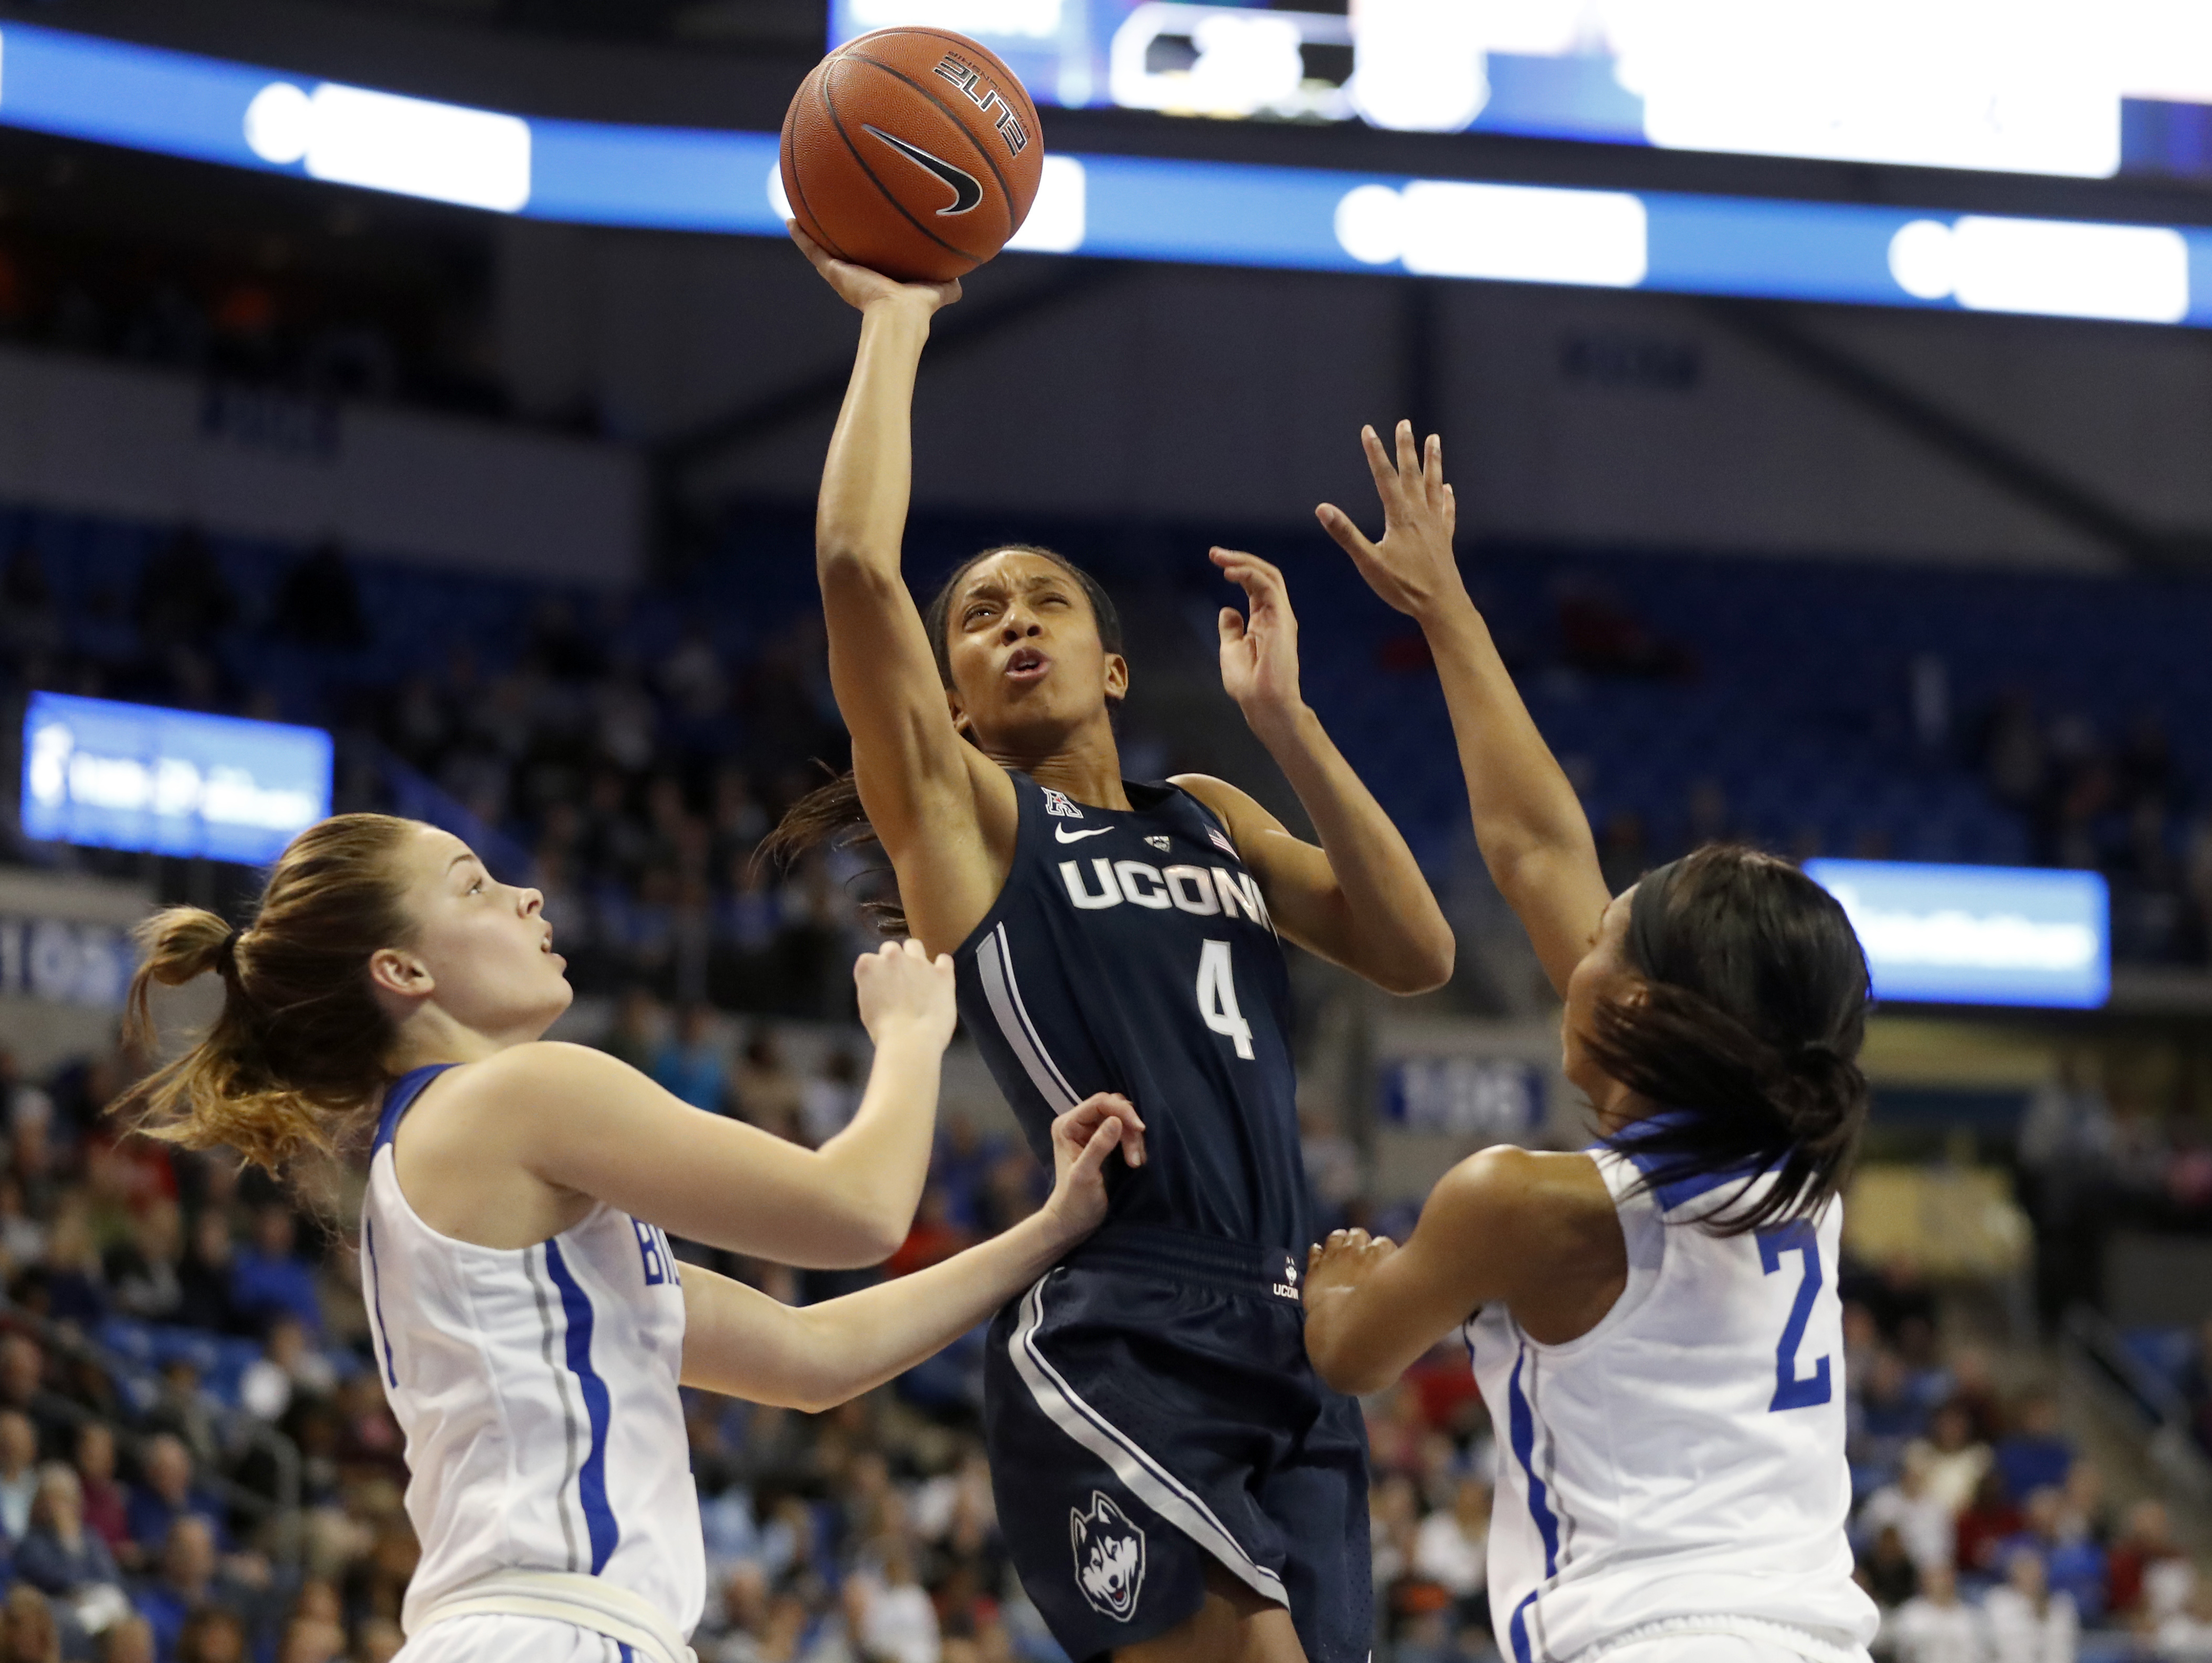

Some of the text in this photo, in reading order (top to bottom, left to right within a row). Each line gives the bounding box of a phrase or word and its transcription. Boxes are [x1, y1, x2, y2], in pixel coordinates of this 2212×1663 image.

[932, 55, 1028, 158] ELITE
[1196, 938, 1256, 1060] 4
[1754, 1216, 1831, 1413] 2
